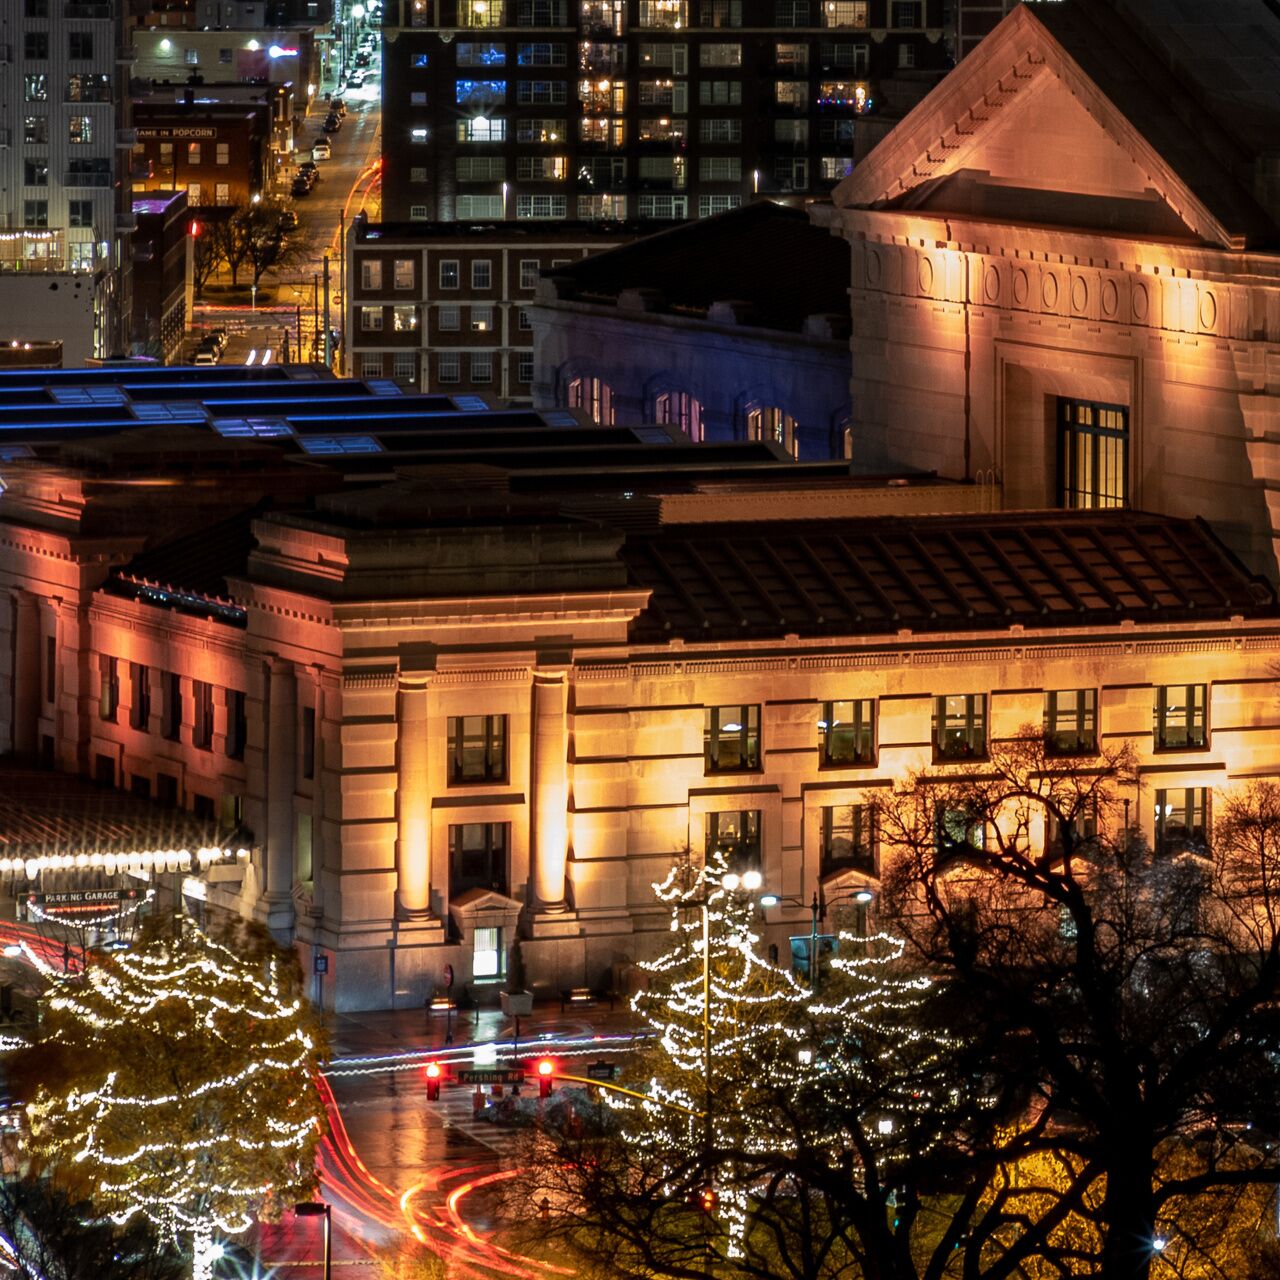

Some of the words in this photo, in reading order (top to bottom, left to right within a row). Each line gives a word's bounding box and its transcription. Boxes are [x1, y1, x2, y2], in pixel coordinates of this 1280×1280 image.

[172, 128, 213, 137] POPCORN
[45, 893, 83, 903] PARKING
[84, 891, 120, 901] GARAGE
[463, 1072, 504, 1083] Pershing
[507, 1071, 519, 1081] Rd
